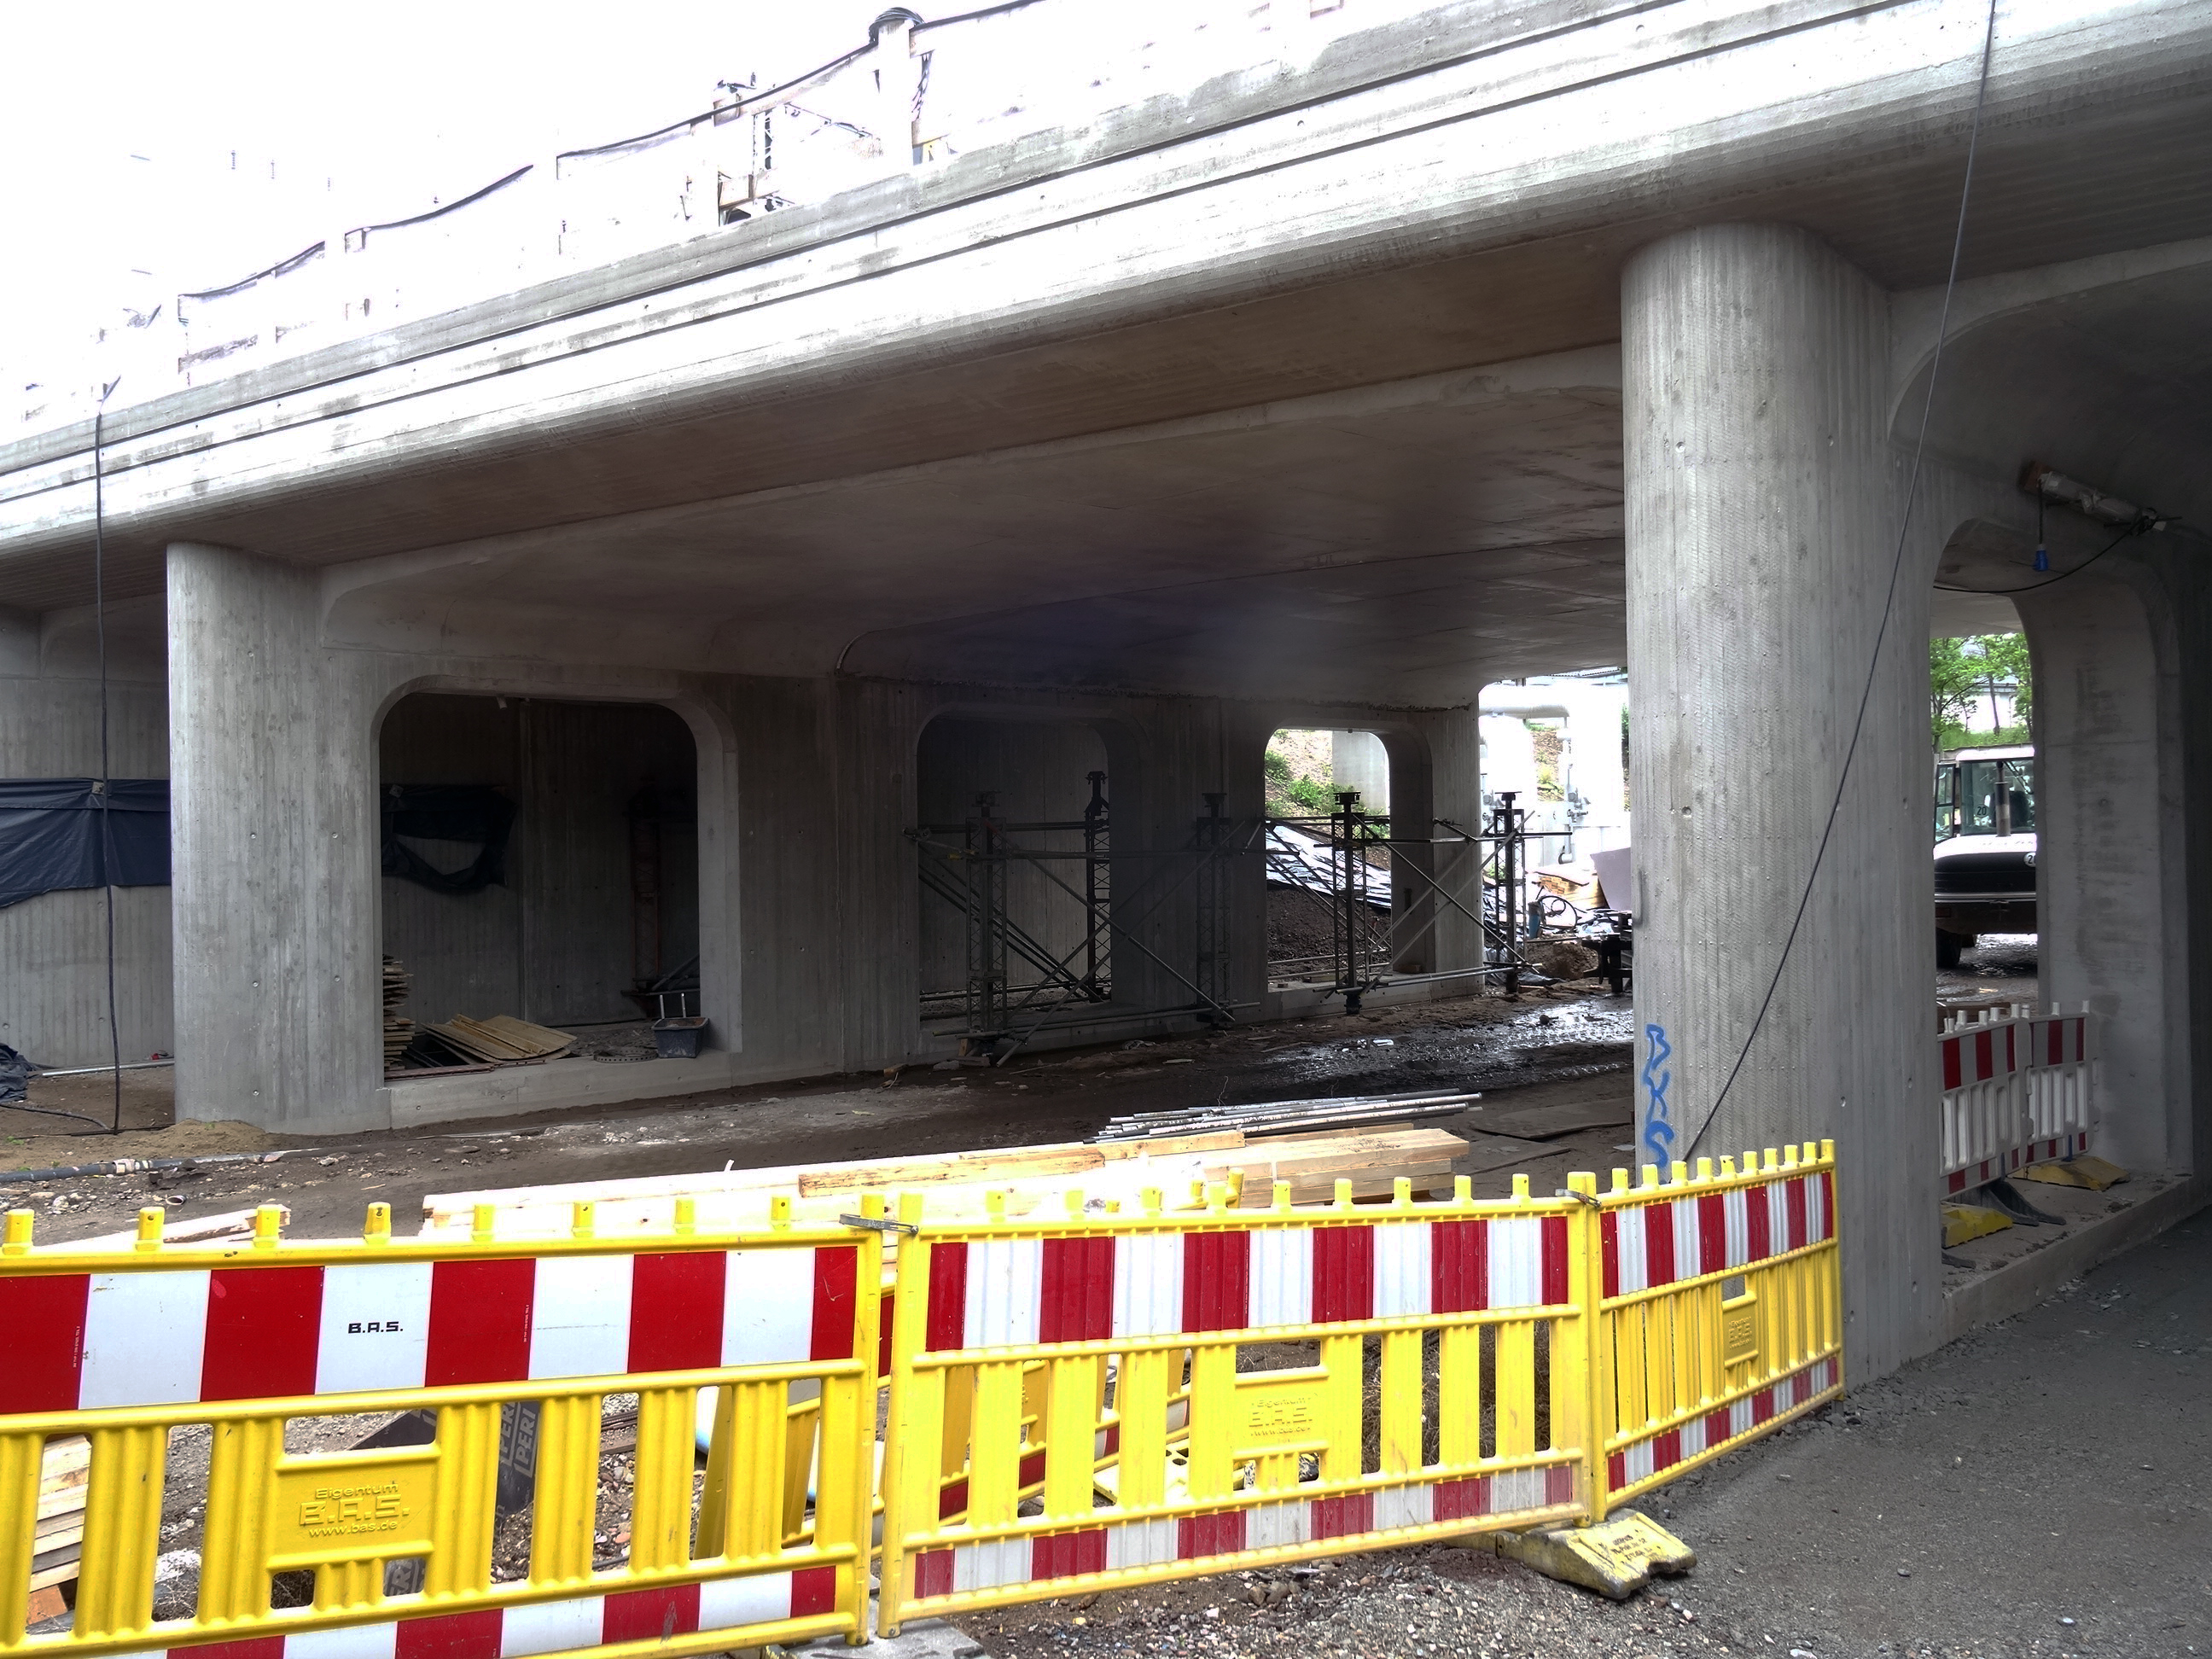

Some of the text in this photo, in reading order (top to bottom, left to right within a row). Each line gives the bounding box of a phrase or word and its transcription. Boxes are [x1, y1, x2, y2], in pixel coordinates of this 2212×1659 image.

[1976, 806, 1987, 816] 20
[348, 1321, 404, 1333] B.A.S.
[515, 1407, 536, 1464] PERI
[315, 1483, 399, 1500] Eigentum
[300, 1494, 410, 1526] B.A.S.
[309, 1520, 398, 1538] www.bas.de
